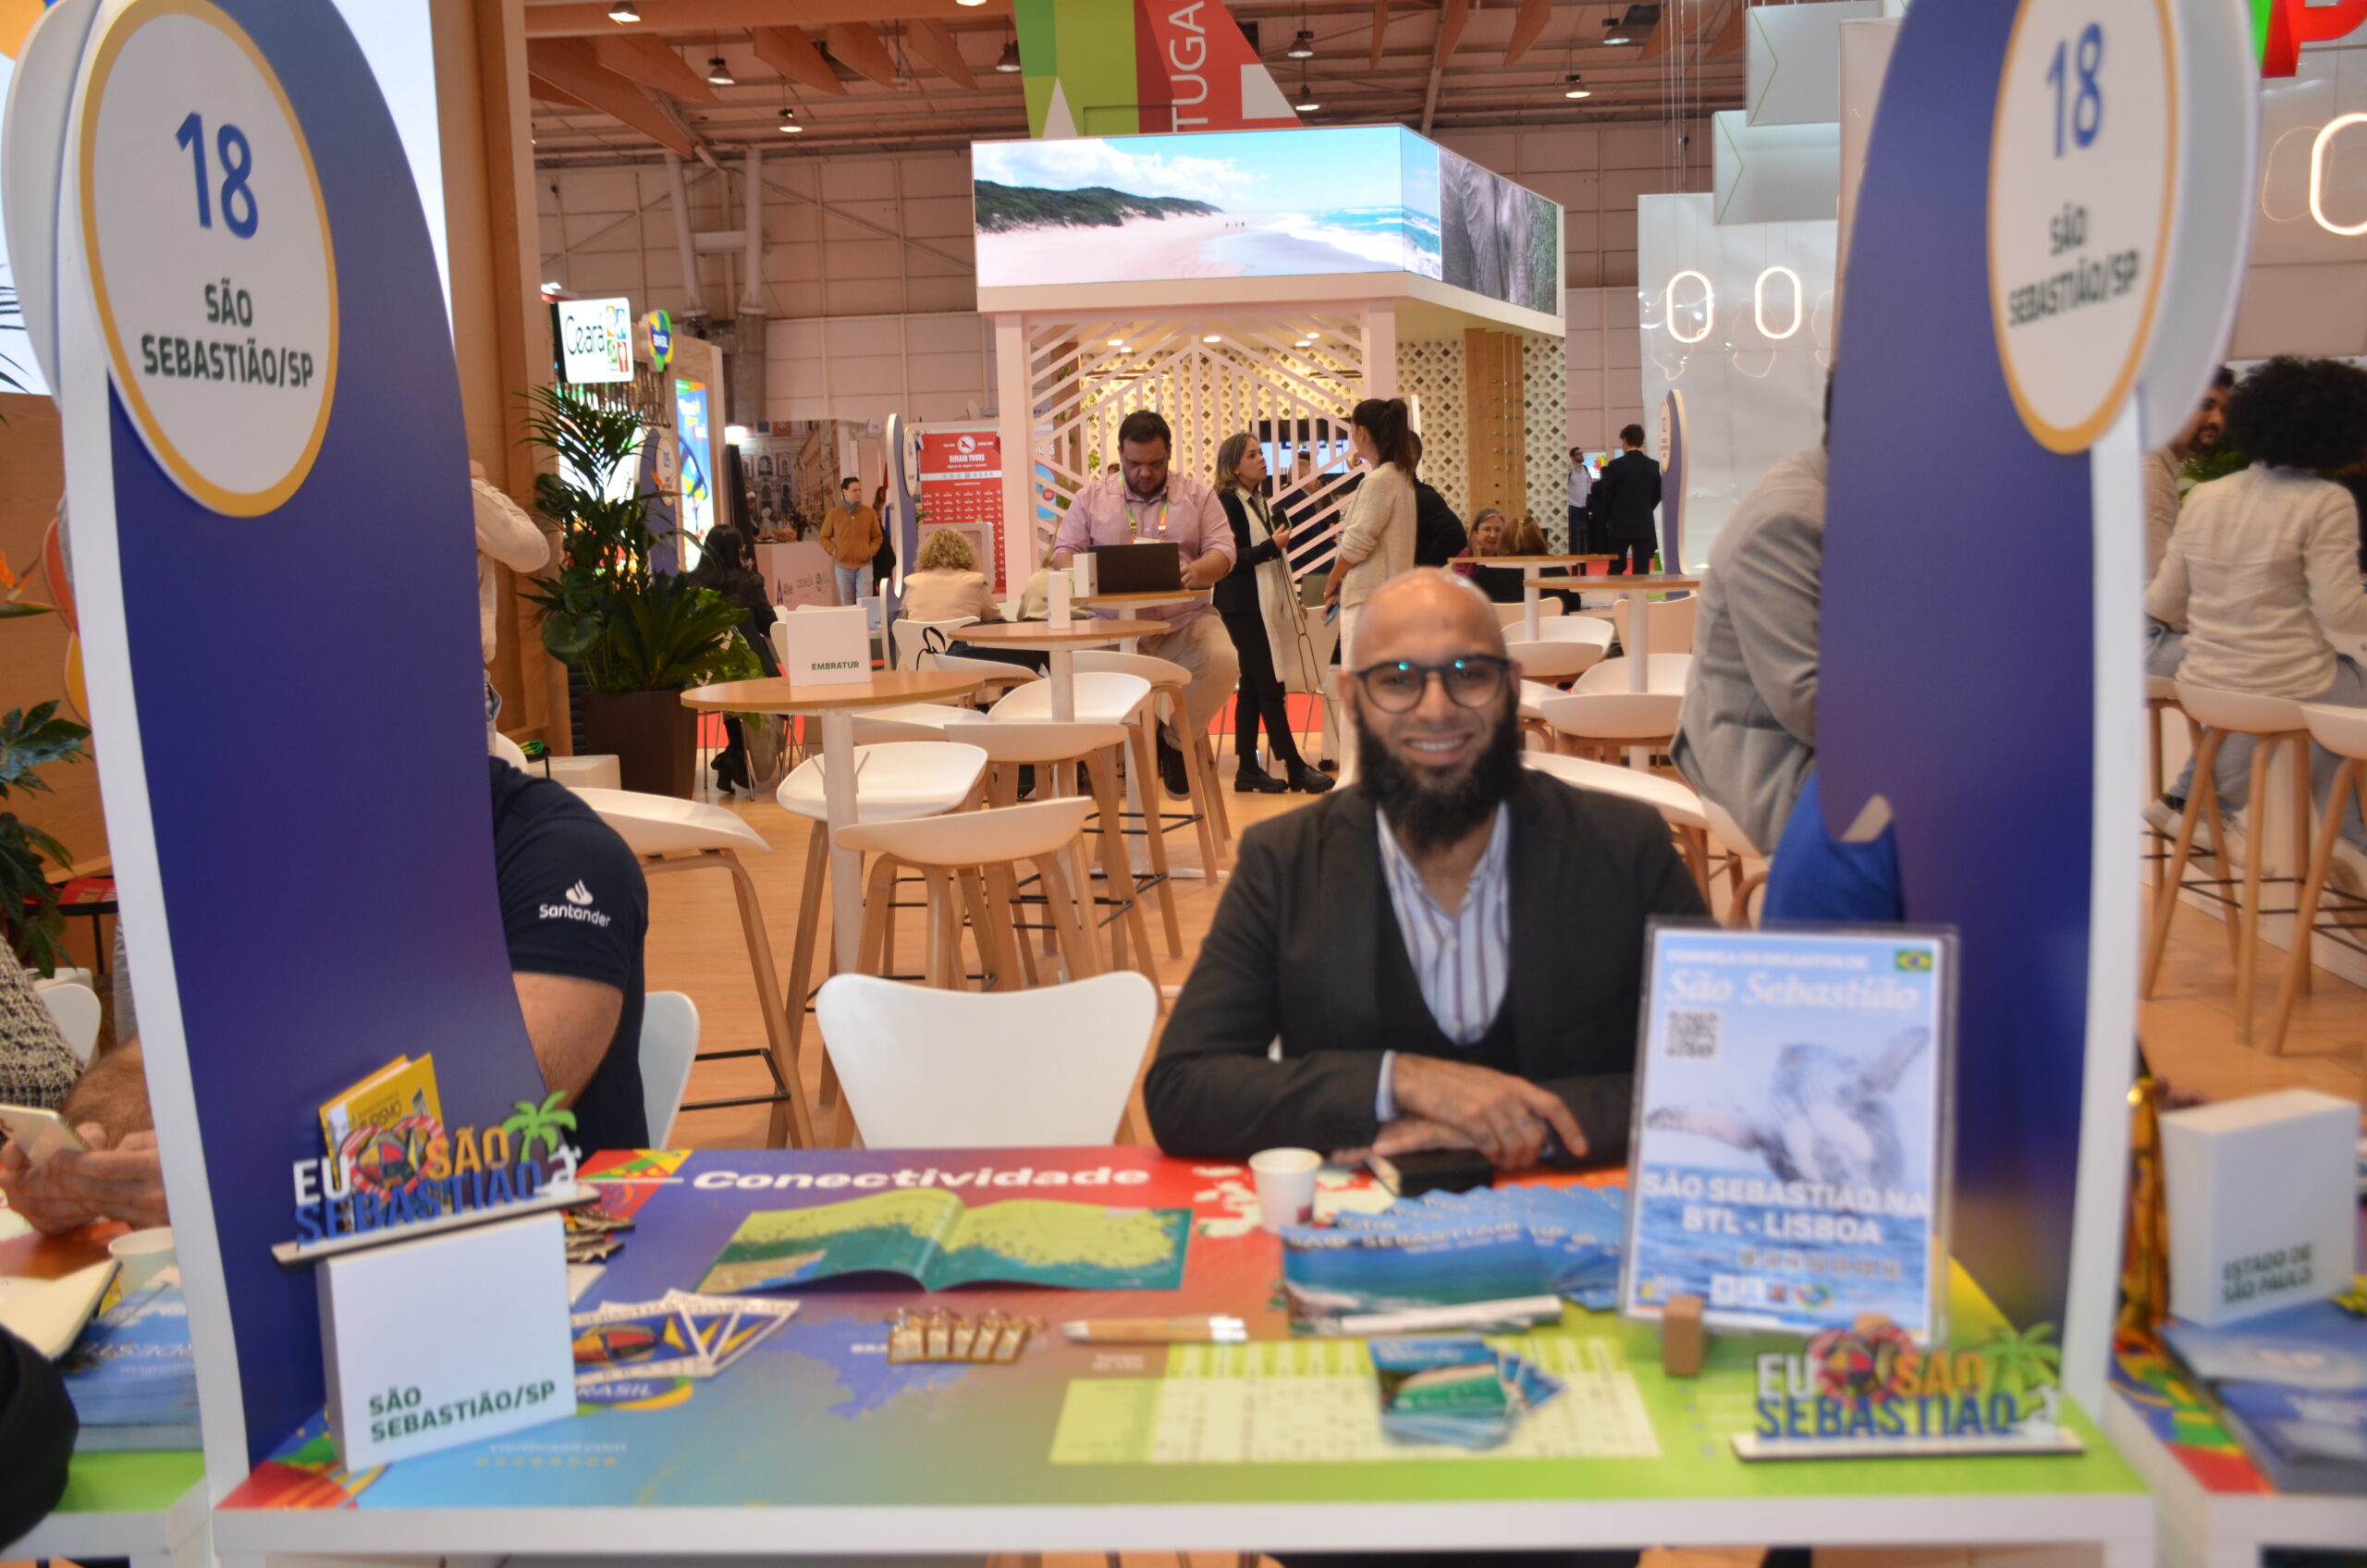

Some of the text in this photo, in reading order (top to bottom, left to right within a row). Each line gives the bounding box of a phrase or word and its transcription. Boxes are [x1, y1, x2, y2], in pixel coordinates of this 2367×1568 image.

[2045, 21, 2103, 160] 18
[175, 111, 259, 239] 18
[2050, 202, 2087, 256] SÃO
[204, 276, 253, 327] SÃO
[2008, 250, 2140, 325] SEBASTIÃO/SP
[565, 307, 607, 356] Ceará
[141, 334, 314, 387] SEBASTIÃO/SP
[812, 661, 859, 670] EMBRATUR
[539, 902, 611, 927] Santander
[1665, 967, 1921, 1011] São Sebastião
[293, 1125, 509, 1206] EU SÃO
[693, 1167, 1150, 1191] Conectividade
[1642, 1170, 1703, 1200] SÃO
[1709, 1175, 1880, 1212] SEBASTIÃO
[1681, 1205, 1741, 1235] BTL
[1764, 1211, 1883, 1245] LISBOA
[2223, 1248, 2287, 1281] ESTADO
[369, 1385, 422, 1416] SÃO
[1756, 1351, 1815, 1402] EU
[371, 1379, 556, 1442] SEBASTIÃO/SP
